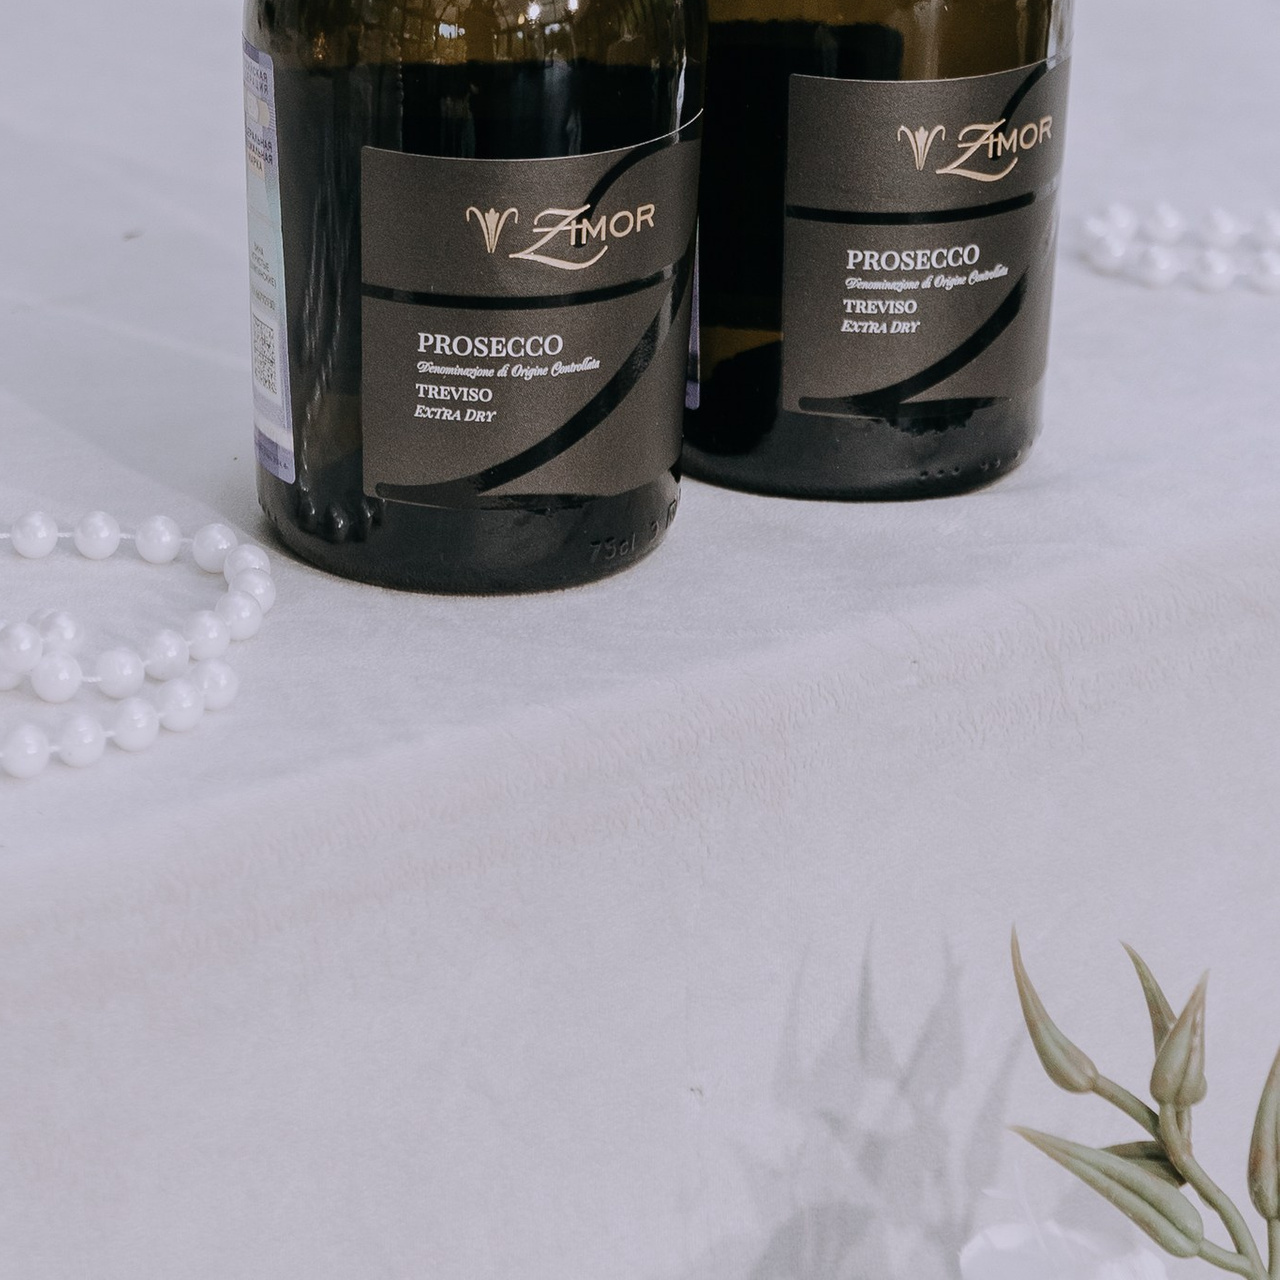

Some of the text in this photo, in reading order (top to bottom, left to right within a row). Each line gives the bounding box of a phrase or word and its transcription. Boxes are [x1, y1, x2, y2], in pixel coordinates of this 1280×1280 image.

[936, 115, 1053, 182] ZIMOR
[509, 203, 655, 270] ZIMOR
[846, 244, 980, 271] PROSECCO
[845, 277, 920, 292] Denominazione
[921, 274, 933, 289] di
[934, 273, 967, 290] Origine
[843, 299, 918, 314] TREVISO
[841, 319, 920, 334] EXTRA DRY
[417, 332, 564, 358] PROSECCO
[417, 356, 601, 380] Denominazione di Origine Controllata
[415, 383, 493, 403] TREVISO
[414, 404, 497, 423] EXTRA DRY
